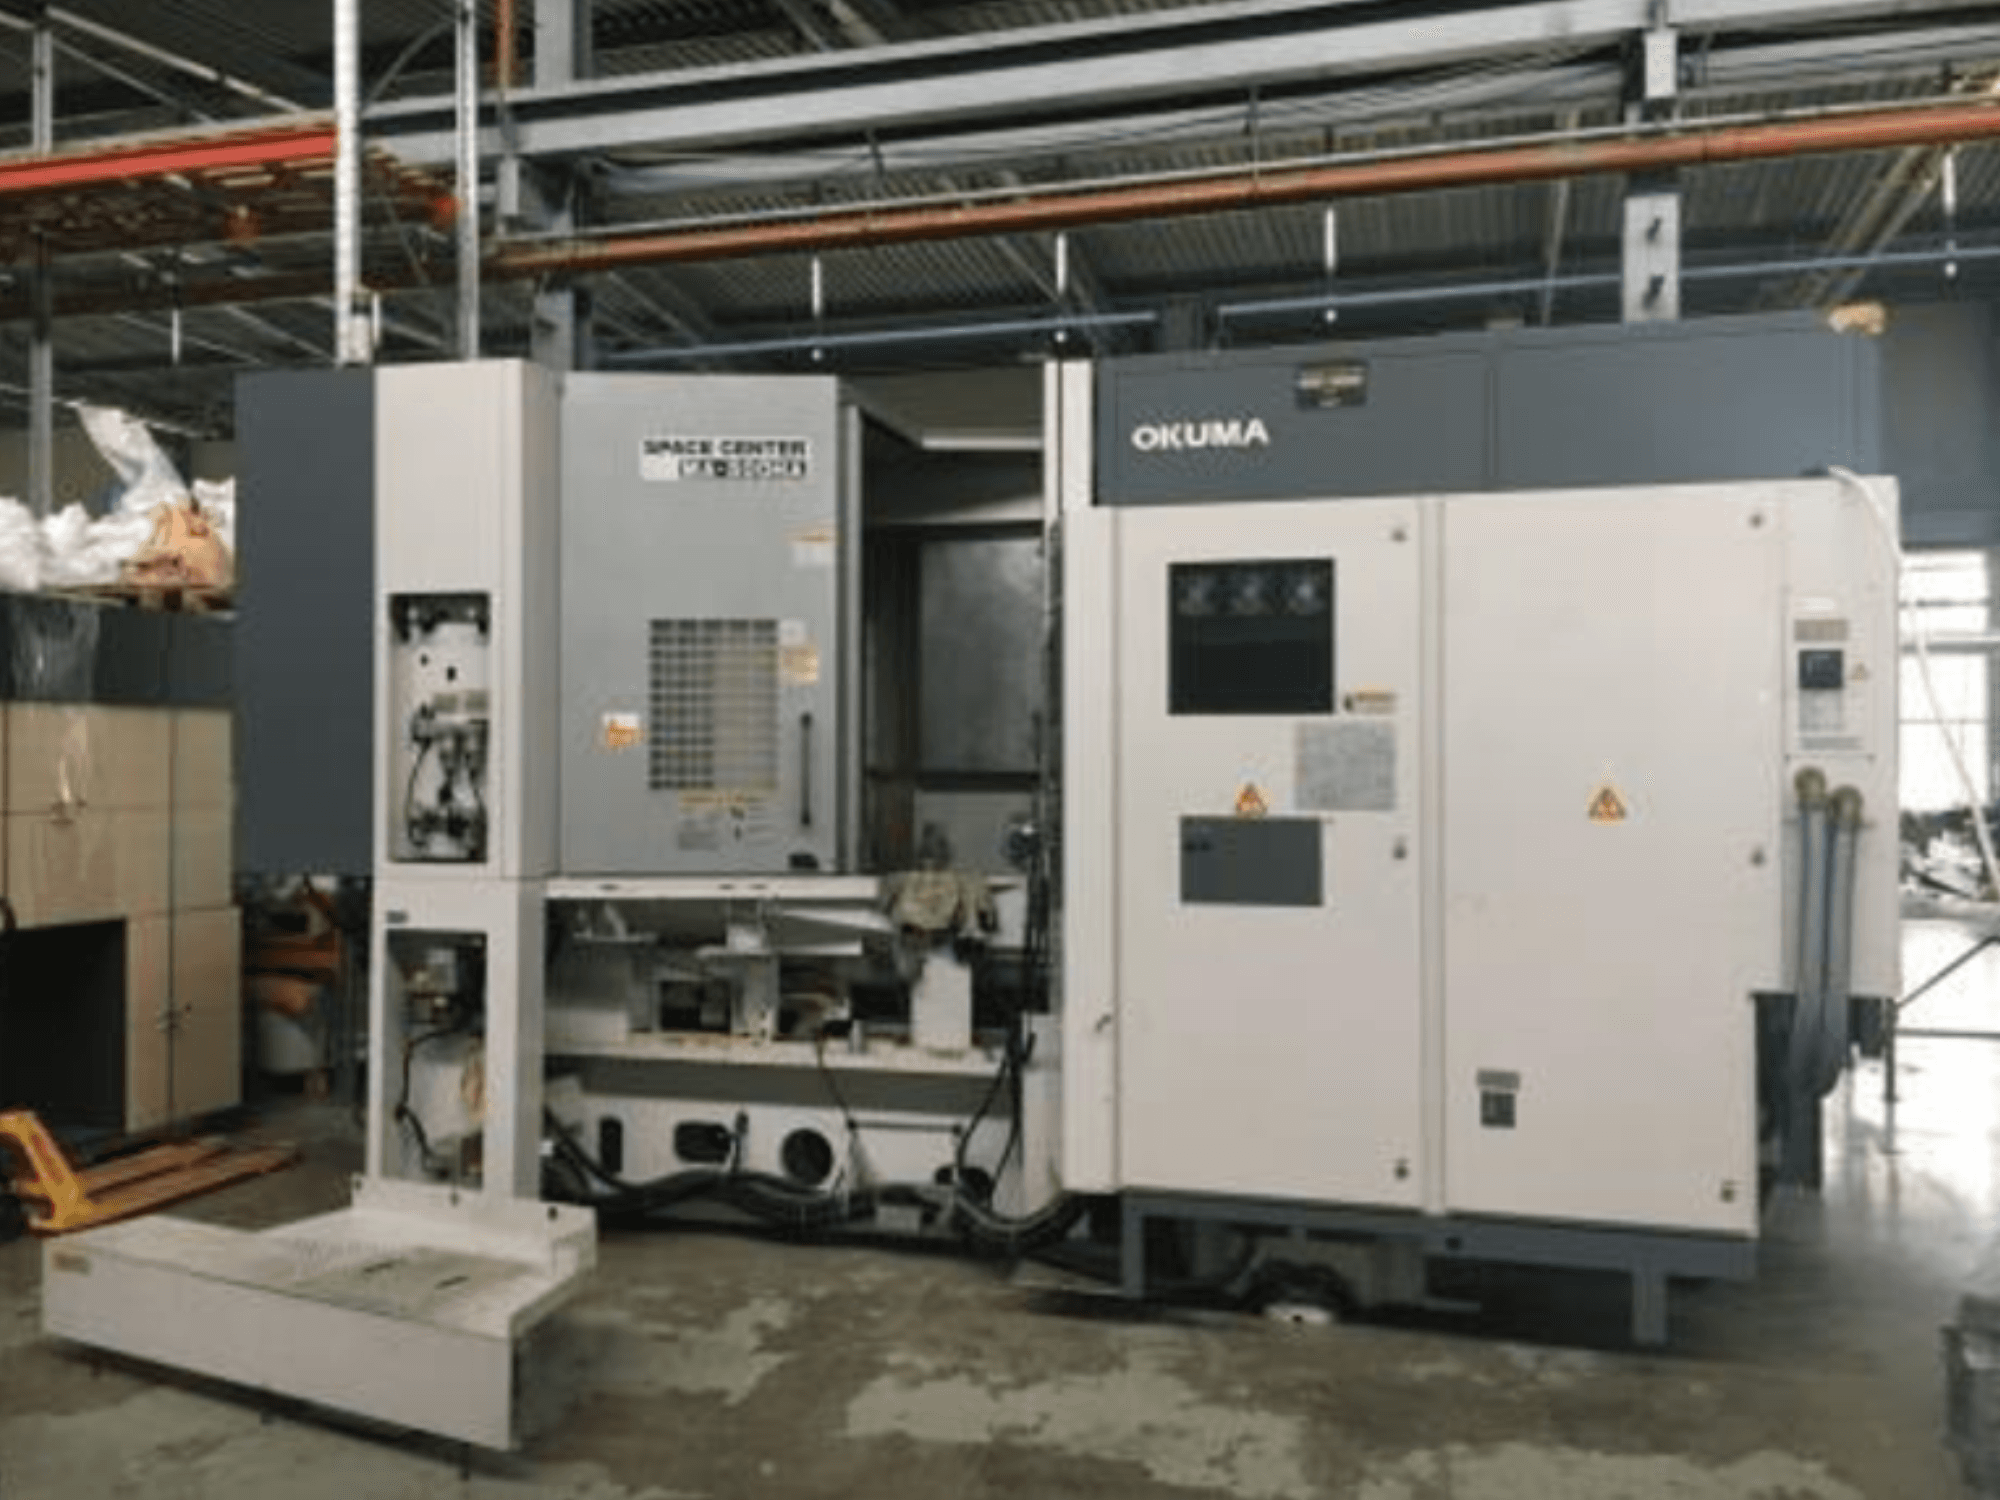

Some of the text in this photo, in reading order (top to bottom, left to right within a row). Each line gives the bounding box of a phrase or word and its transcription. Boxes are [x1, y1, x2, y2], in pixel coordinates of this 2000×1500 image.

[1131, 416, 1270, 451] OKUMA
[643, 439, 807, 456] SPACE CENTER
